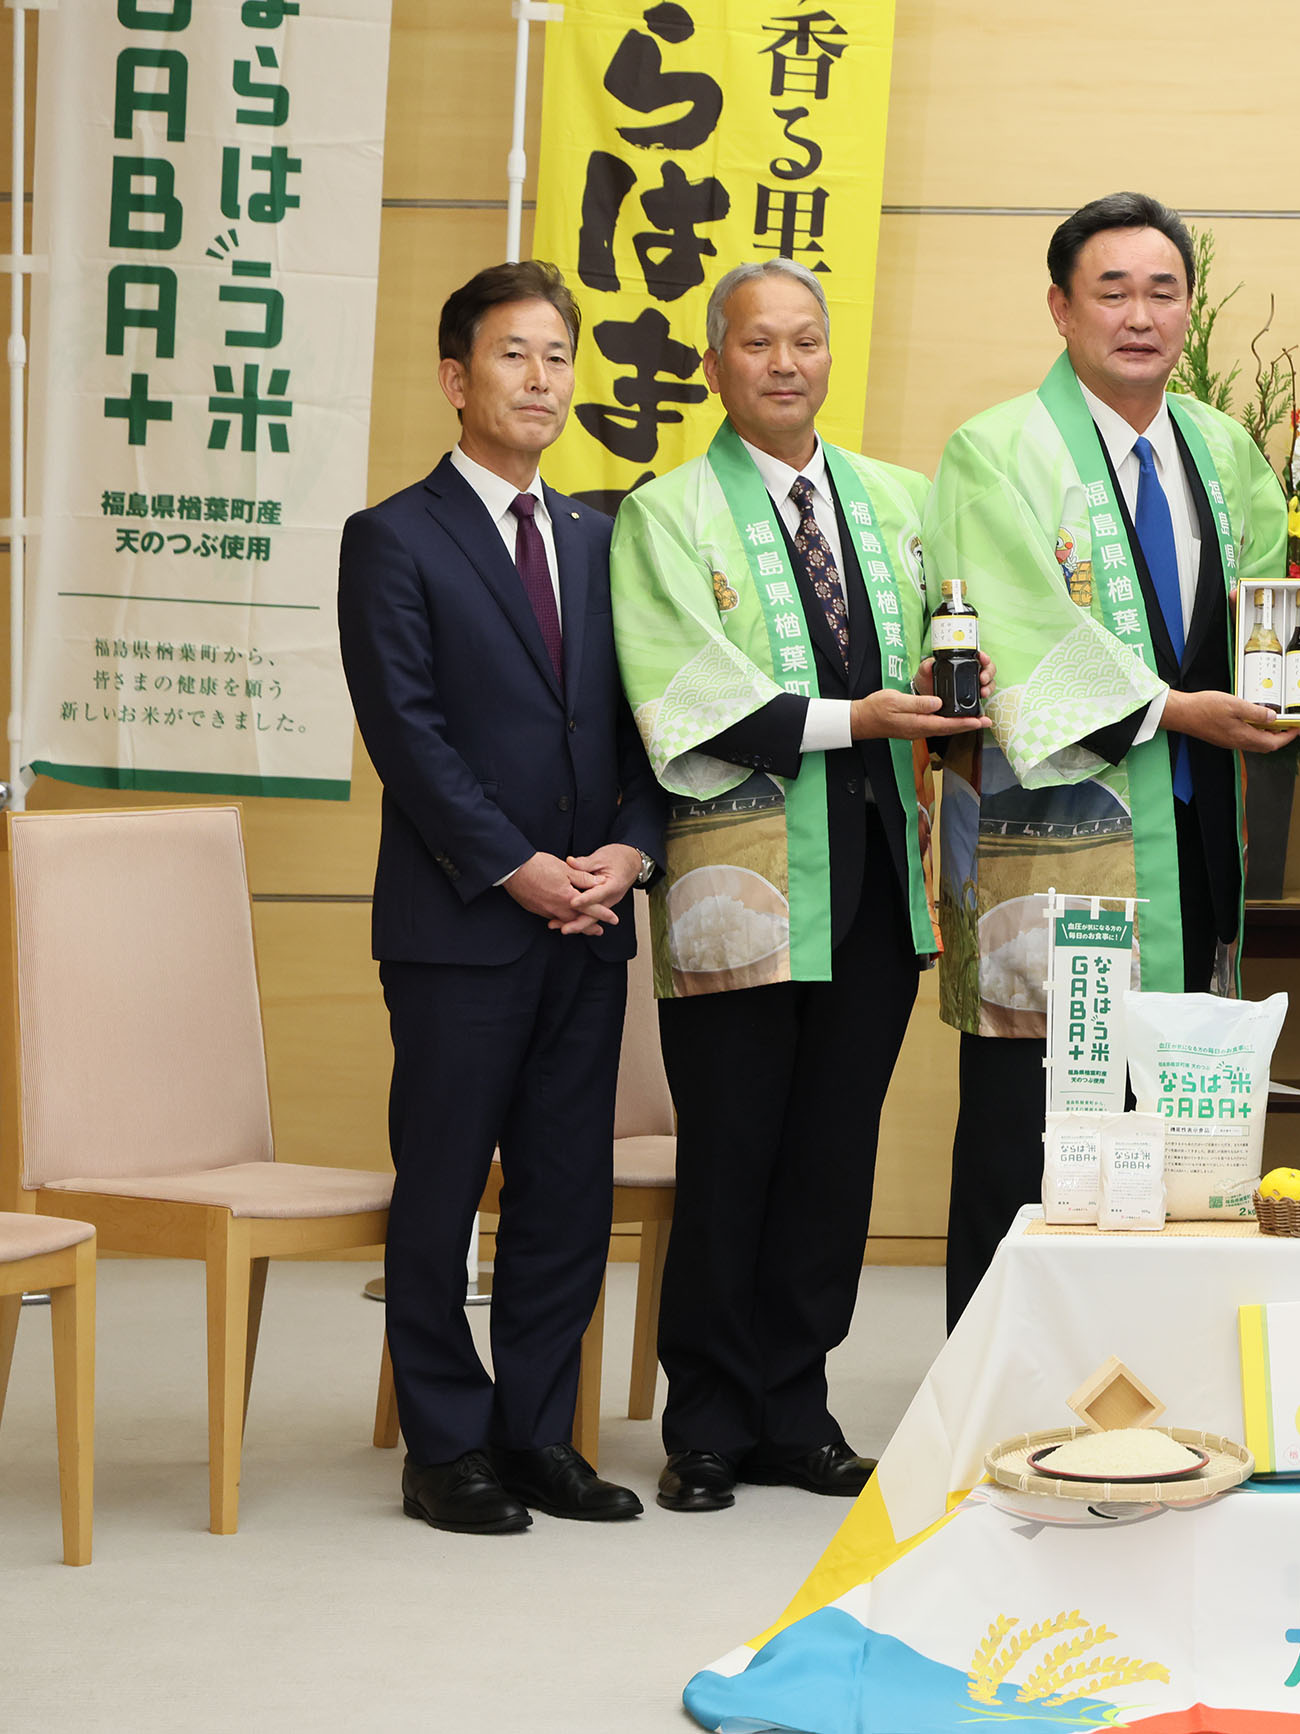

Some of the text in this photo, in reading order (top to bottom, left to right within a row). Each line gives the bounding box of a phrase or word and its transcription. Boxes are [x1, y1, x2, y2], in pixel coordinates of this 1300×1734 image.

[752, 10, 849, 273] 香る里
[570, 1, 731, 520] らはま
[101, 490, 283, 525] 福島県楢葉町産
[115, 527, 272, 562] 天のつぶ使用
[849, 500, 904, 681] 福島県楢葉町
[95, 637, 280, 667] 福島県楢葉町から、
[93, 669, 283, 701] 皆さまの健康を願う
[60, 700, 307, 734] 新しいお米ができました。
[1068, 955, 1088, 1061] GABA+
[1091, 956, 1112, 1062] ならはう米
[1157, 1097, 1252, 1118] GABA+
[1060, 1154, 1097, 1162] GABA+
[1114, 1161, 1151, 1169] GABA+
